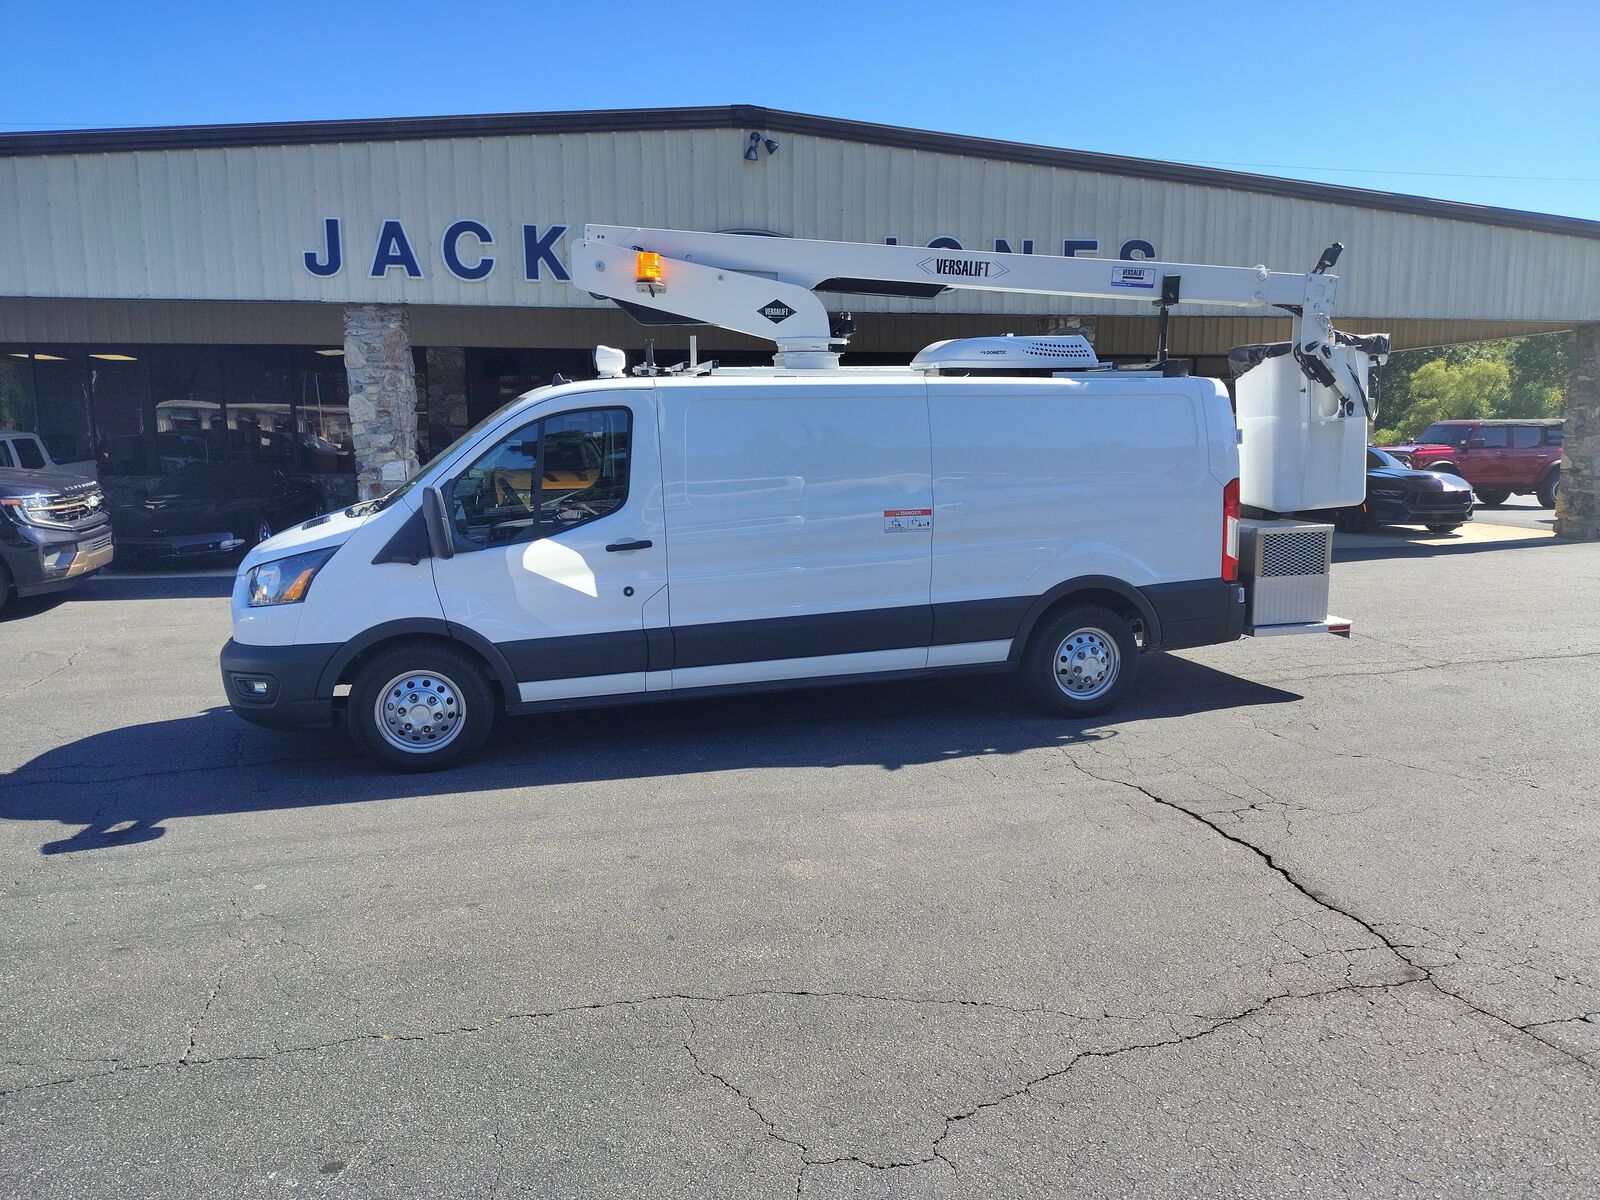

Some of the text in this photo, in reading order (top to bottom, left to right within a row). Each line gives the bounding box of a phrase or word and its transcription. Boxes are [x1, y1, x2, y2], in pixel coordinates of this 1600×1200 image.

[303, 217, 572, 283] JACK
[936, 258, 991, 278] VERSALIFT
[764, 307, 789, 316] VERSALIFT
